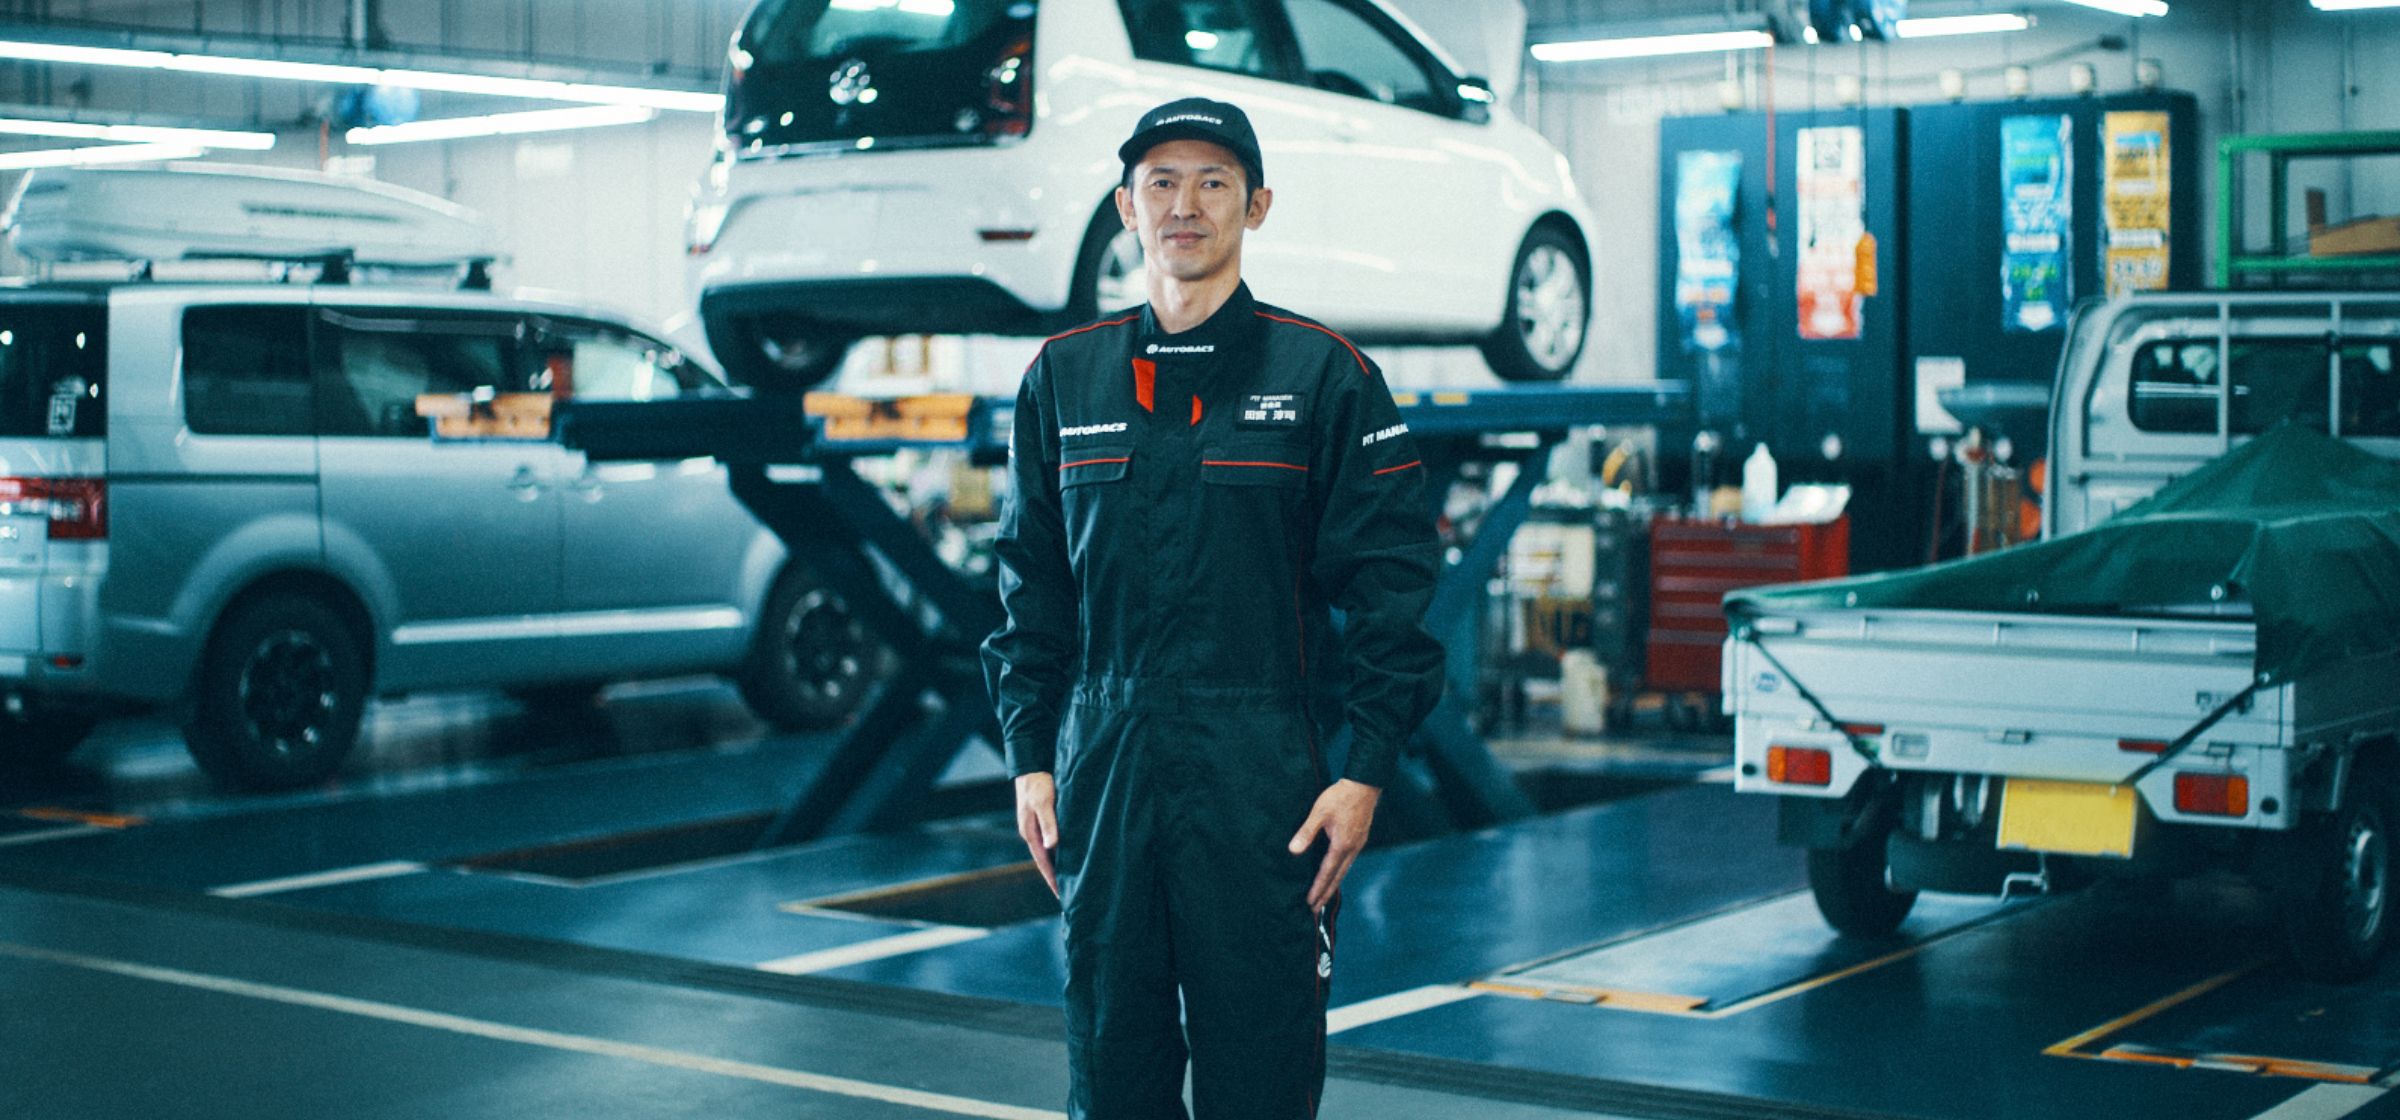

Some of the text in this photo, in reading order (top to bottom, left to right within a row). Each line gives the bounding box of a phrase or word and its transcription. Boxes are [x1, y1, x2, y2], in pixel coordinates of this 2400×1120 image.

[1165, 115, 1223, 125] AUTOBACS
[1159, 345, 1215, 354] AUTOBACS
[1059, 422, 1128, 437] AUTOBACS
[1362, 422, 1409, 447] PIT MANA
